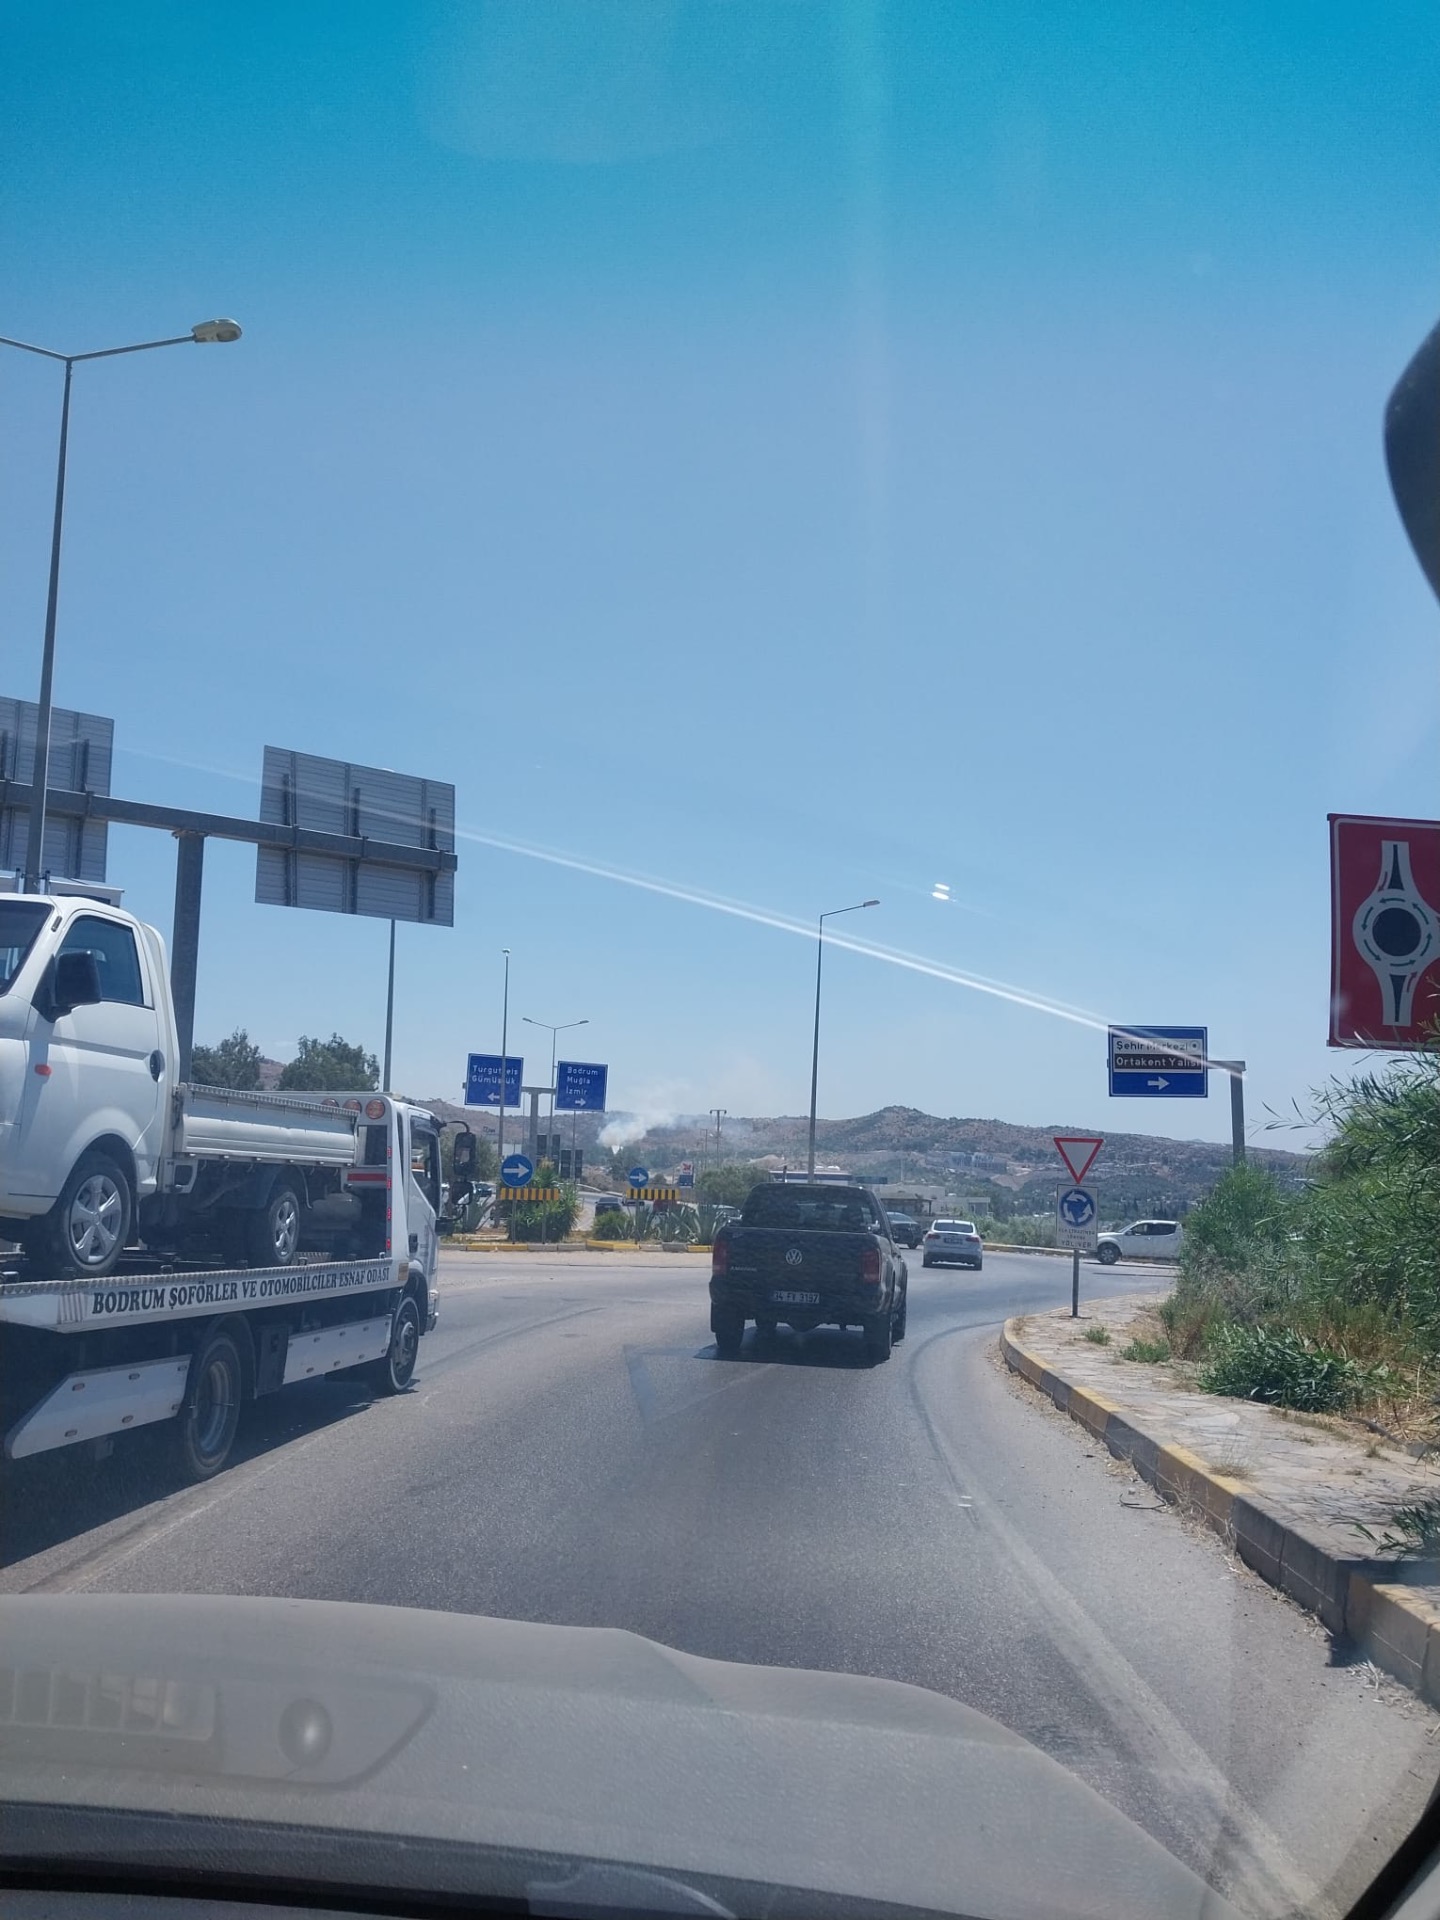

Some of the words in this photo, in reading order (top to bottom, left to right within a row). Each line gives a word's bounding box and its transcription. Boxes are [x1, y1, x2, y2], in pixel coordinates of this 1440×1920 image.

[1116, 1057, 1166, 1067] Ortakent
[472, 1065, 518, 1075] Turguteis
[567, 1066, 599, 1076] Bodrum
[92, 1287, 165, 1314] BODRUM
[168, 1280, 238, 1310] ŞOFÖRLER
[242, 1279, 257, 1299] VE
[259, 1271, 337, 1298] OTOMOBİLCİLER
[338, 1269, 366, 1287] ESNAF
[366, 1267, 390, 1284] ODASI
